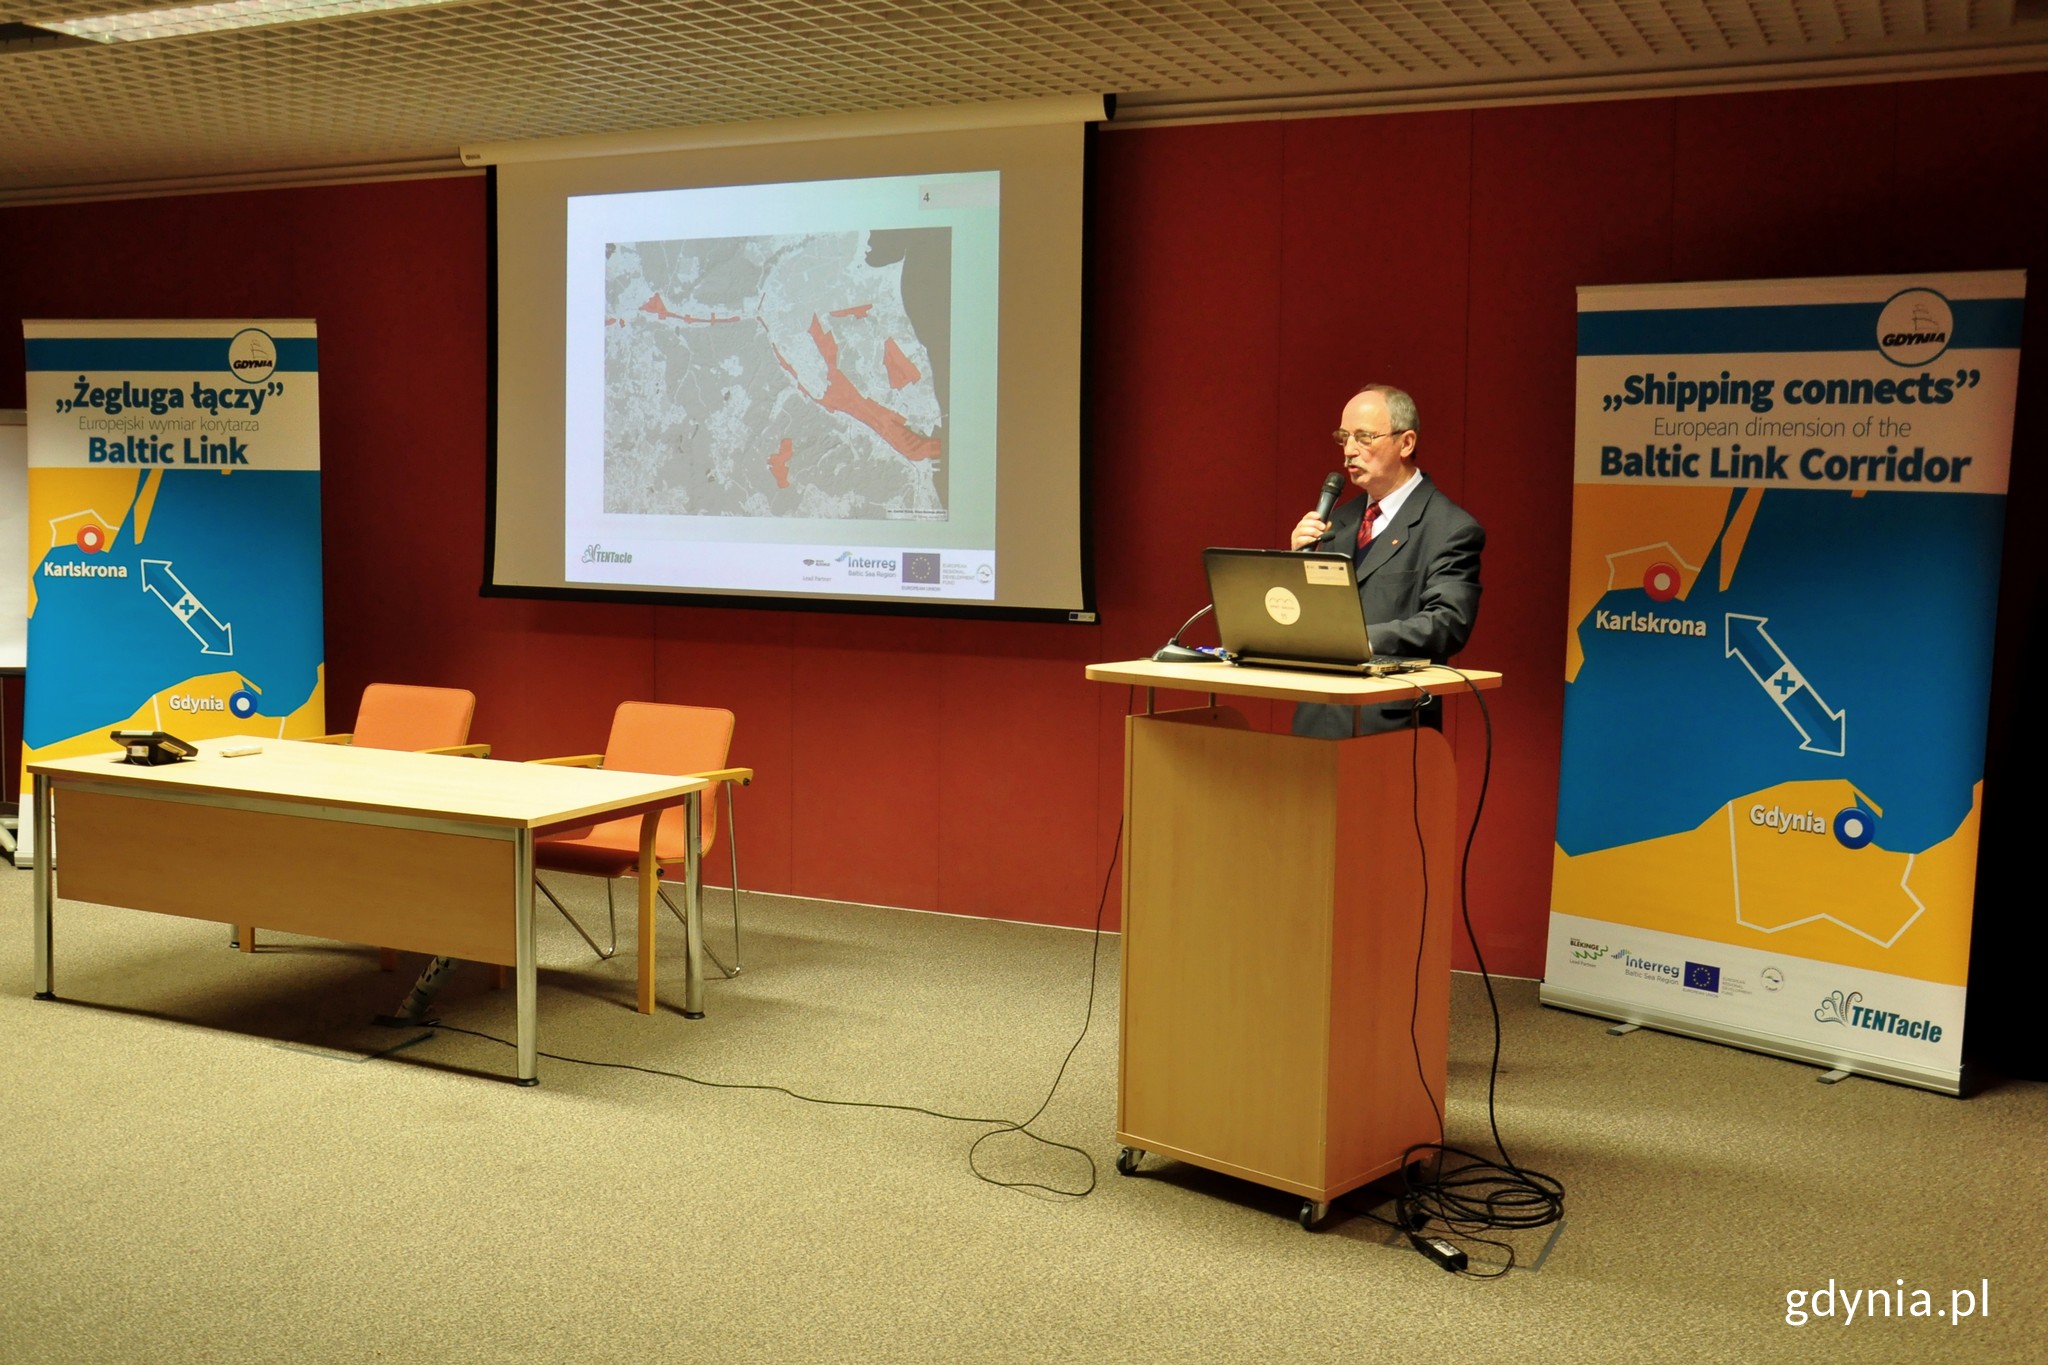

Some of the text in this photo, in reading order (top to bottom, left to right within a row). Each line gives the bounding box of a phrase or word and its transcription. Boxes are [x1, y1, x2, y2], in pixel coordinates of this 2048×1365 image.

[922, 192, 930, 203] 4
[1882, 331, 1946, 348] GDYNIA
[233, 359, 273, 370] GDYNIA
[78, 416, 260, 435] Europejski wymiar korytarza
[1653, 416, 1912, 442] European dimension of the
[88, 434, 249, 465] Baltic Link
[1600, 444, 1973, 484] Baltic Link Corridor
[596, 551, 633, 564] TENTacle
[848, 556, 897, 571] Interreg
[43, 562, 128, 579] Karlskrona
[1595, 610, 1707, 637] Karlskrona
[169, 695, 225, 713] Gdynia
[1749, 804, 1827, 834] Gdynia
[1570, 940, 1599, 951] BLEKINGE
[1625, 955, 1680, 978] Interreg
[1625, 969, 1680, 985] Baltic Sea Region
[1851, 1005, 1943, 1043] TENTacle
